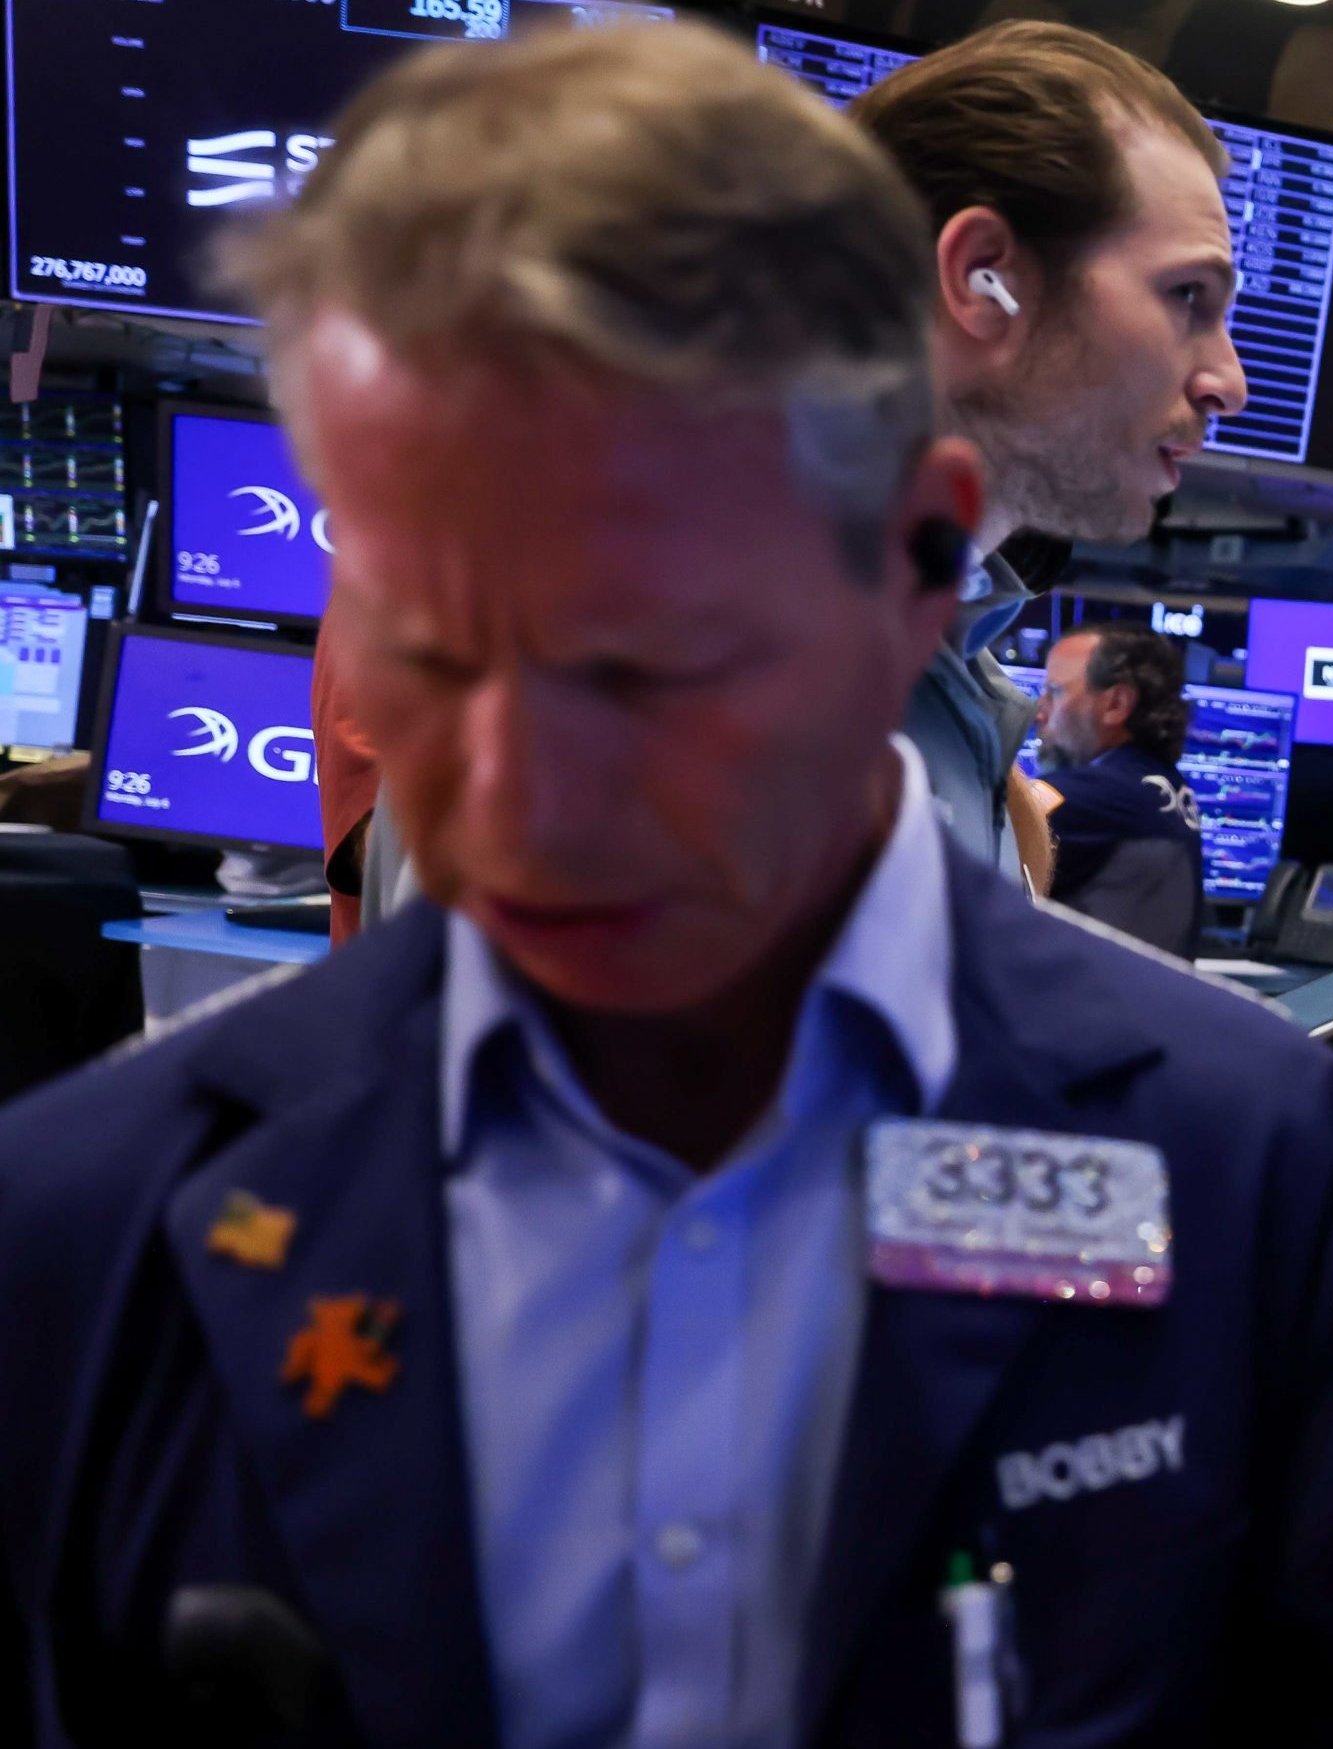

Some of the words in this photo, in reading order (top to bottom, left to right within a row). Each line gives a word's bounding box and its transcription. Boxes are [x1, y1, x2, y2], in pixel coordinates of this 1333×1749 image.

[30, 255, 147, 287] 276,767,000
[920, 1138, 1112, 1216] 3333
[996, 1412, 1186, 1510] BOBBY
